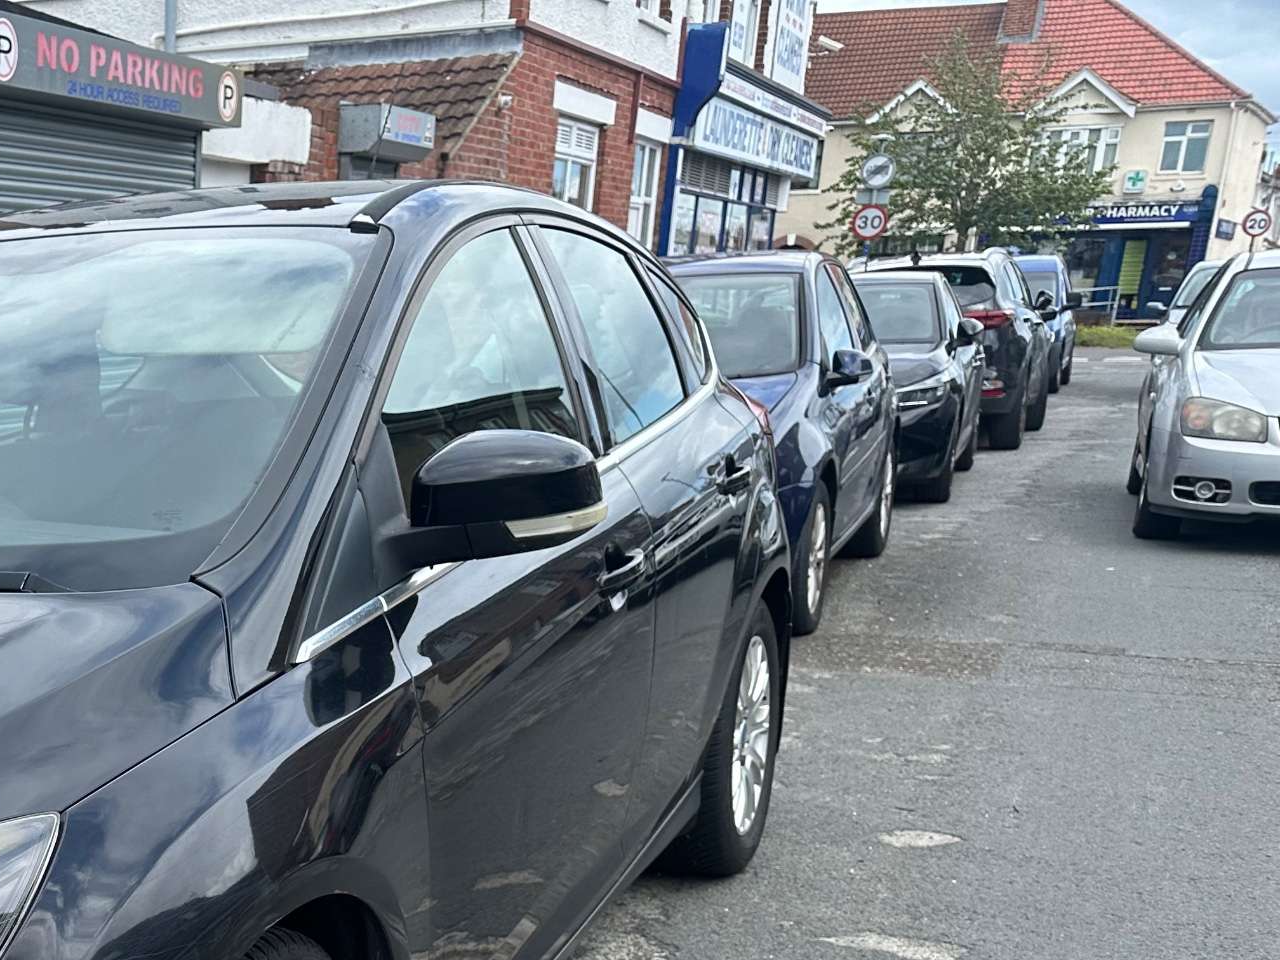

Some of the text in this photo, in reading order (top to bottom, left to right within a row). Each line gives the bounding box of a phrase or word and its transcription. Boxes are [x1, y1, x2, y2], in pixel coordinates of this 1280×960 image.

[36, 32, 204, 98] NO PARKING
[80, 82, 105, 101] HOUR
[1095, 205, 1180, 218] PHARMACY
[857, 215, 882, 230] 30
[1248, 218, 1268, 230] 20
